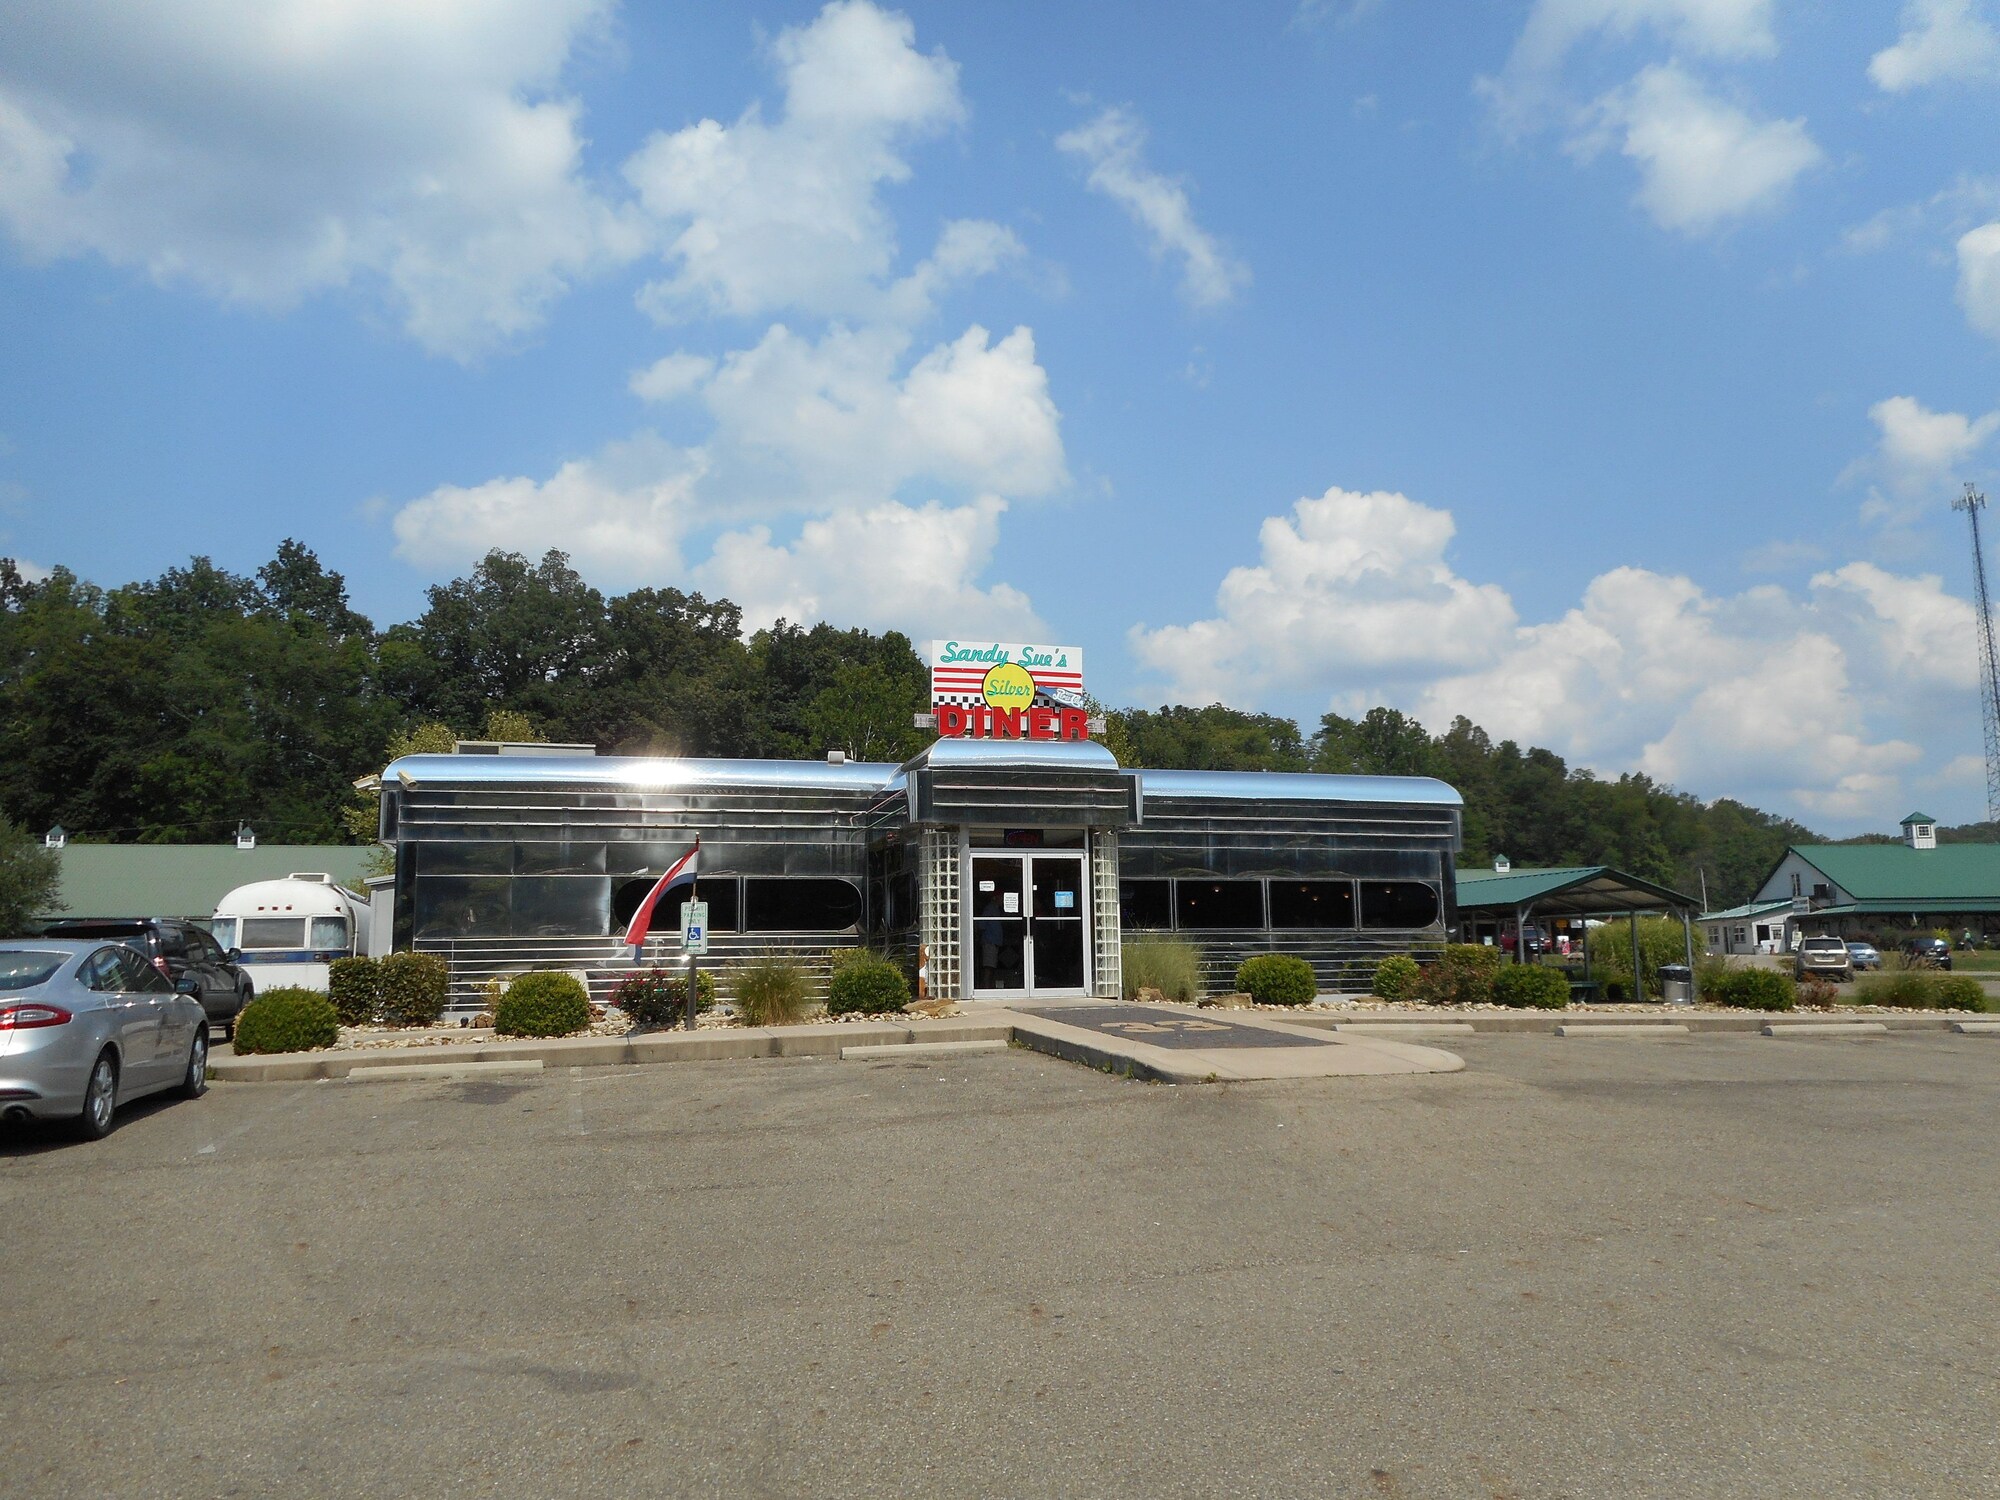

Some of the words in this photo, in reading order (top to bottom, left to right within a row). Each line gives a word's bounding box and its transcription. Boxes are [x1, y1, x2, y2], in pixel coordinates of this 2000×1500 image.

[940, 642, 1009, 668] Sandy
[1018, 646, 1067, 667] Sue's
[986, 680, 1031, 696] Silver
[938, 704, 1088, 739] DINER
